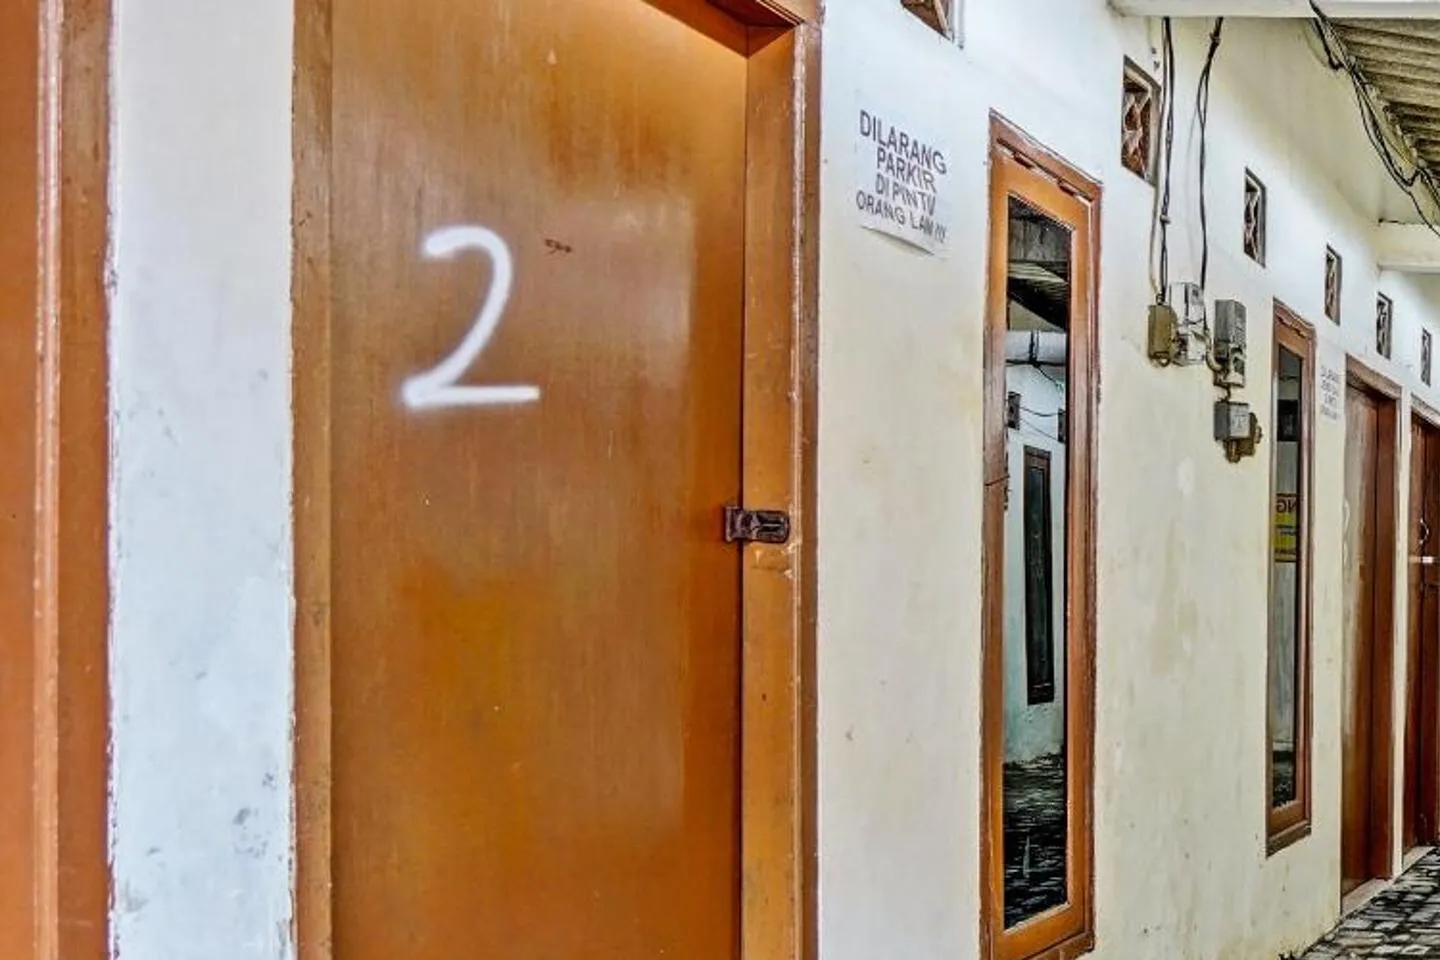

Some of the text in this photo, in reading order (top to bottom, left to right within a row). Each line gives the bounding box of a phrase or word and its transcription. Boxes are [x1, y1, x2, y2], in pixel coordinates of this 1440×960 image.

[860, 109, 947, 174] DILARANG
[877, 147, 937, 193] PARKIR
[856, 190, 905, 225] ORANG
[875, 173, 936, 216] DI PINTU
[403, 225, 541, 406] 2
